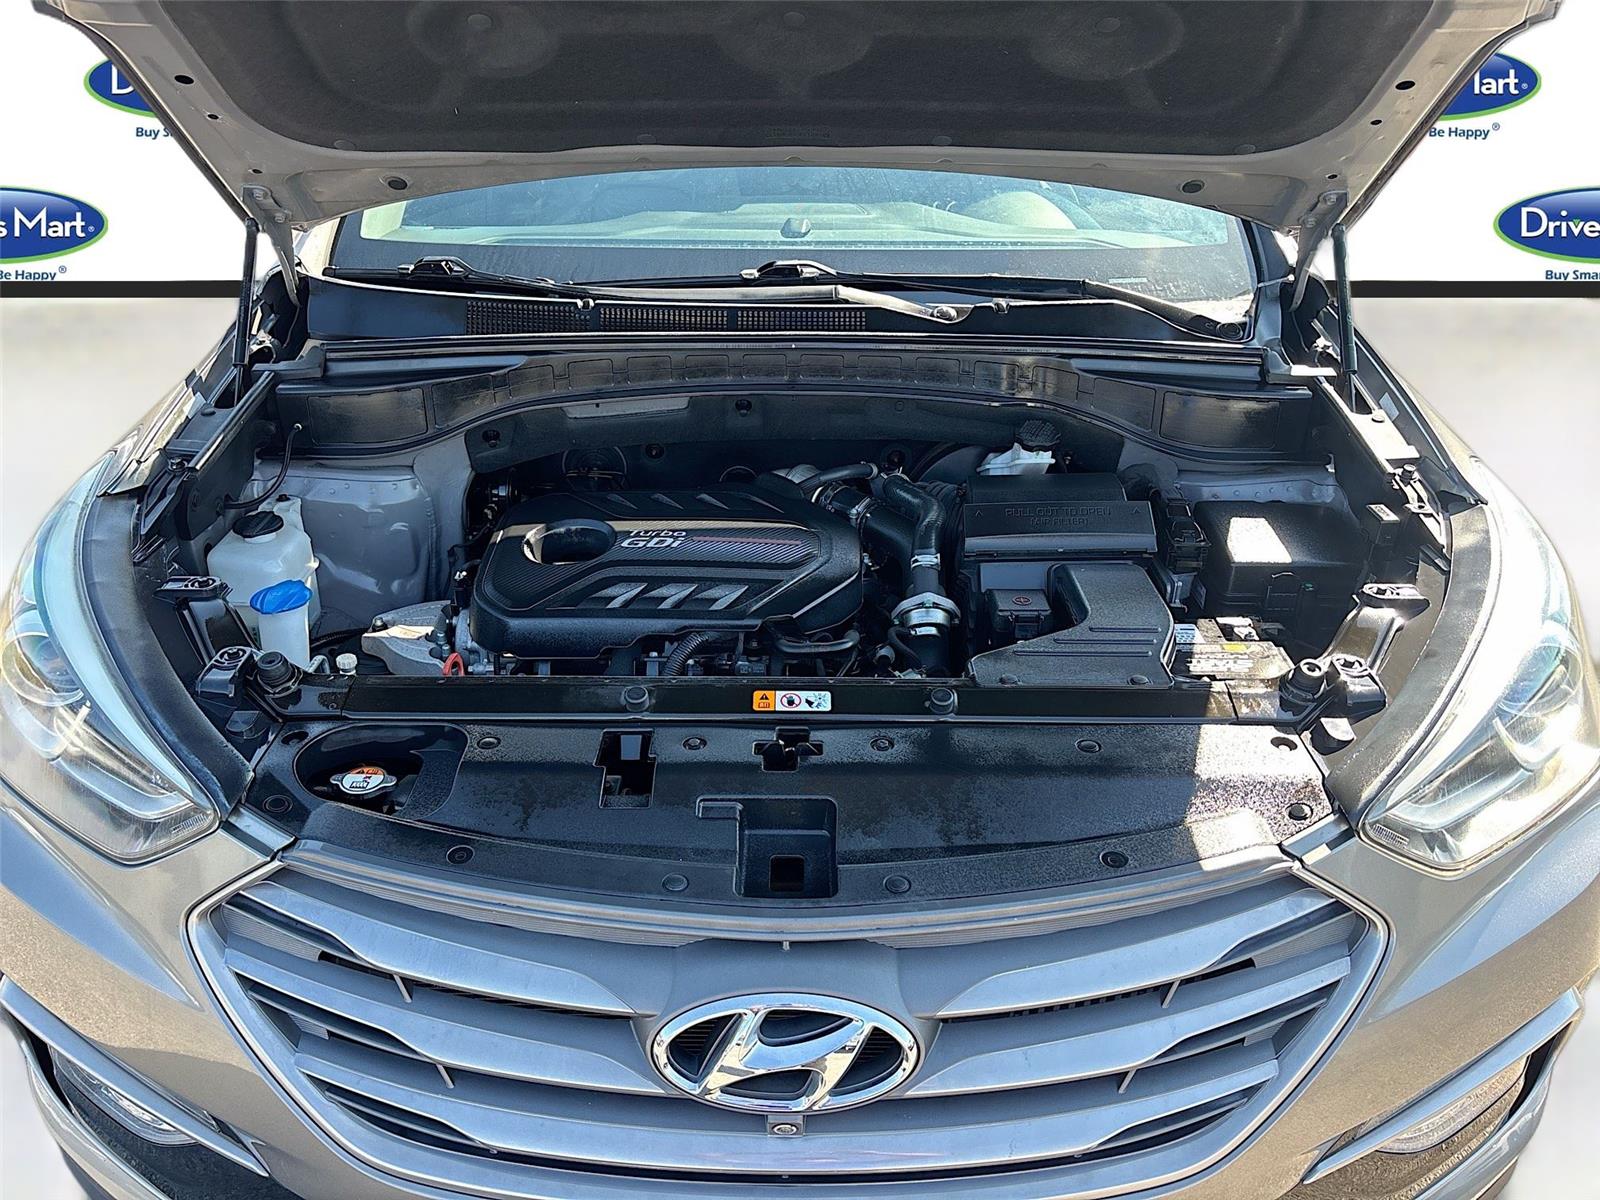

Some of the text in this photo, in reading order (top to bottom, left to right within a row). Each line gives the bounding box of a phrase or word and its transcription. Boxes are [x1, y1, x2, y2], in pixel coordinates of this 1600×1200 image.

[1474, 69, 1519, 94] art
[136, 127, 160, 140] Buy
[1429, 127, 1490, 140] Be Happy
[14, 206, 86, 238] Mart
[15, 270, 57, 281] Happy
[1545, 270, 1570, 281] Buy
[621, 537, 685, 548] GDi
